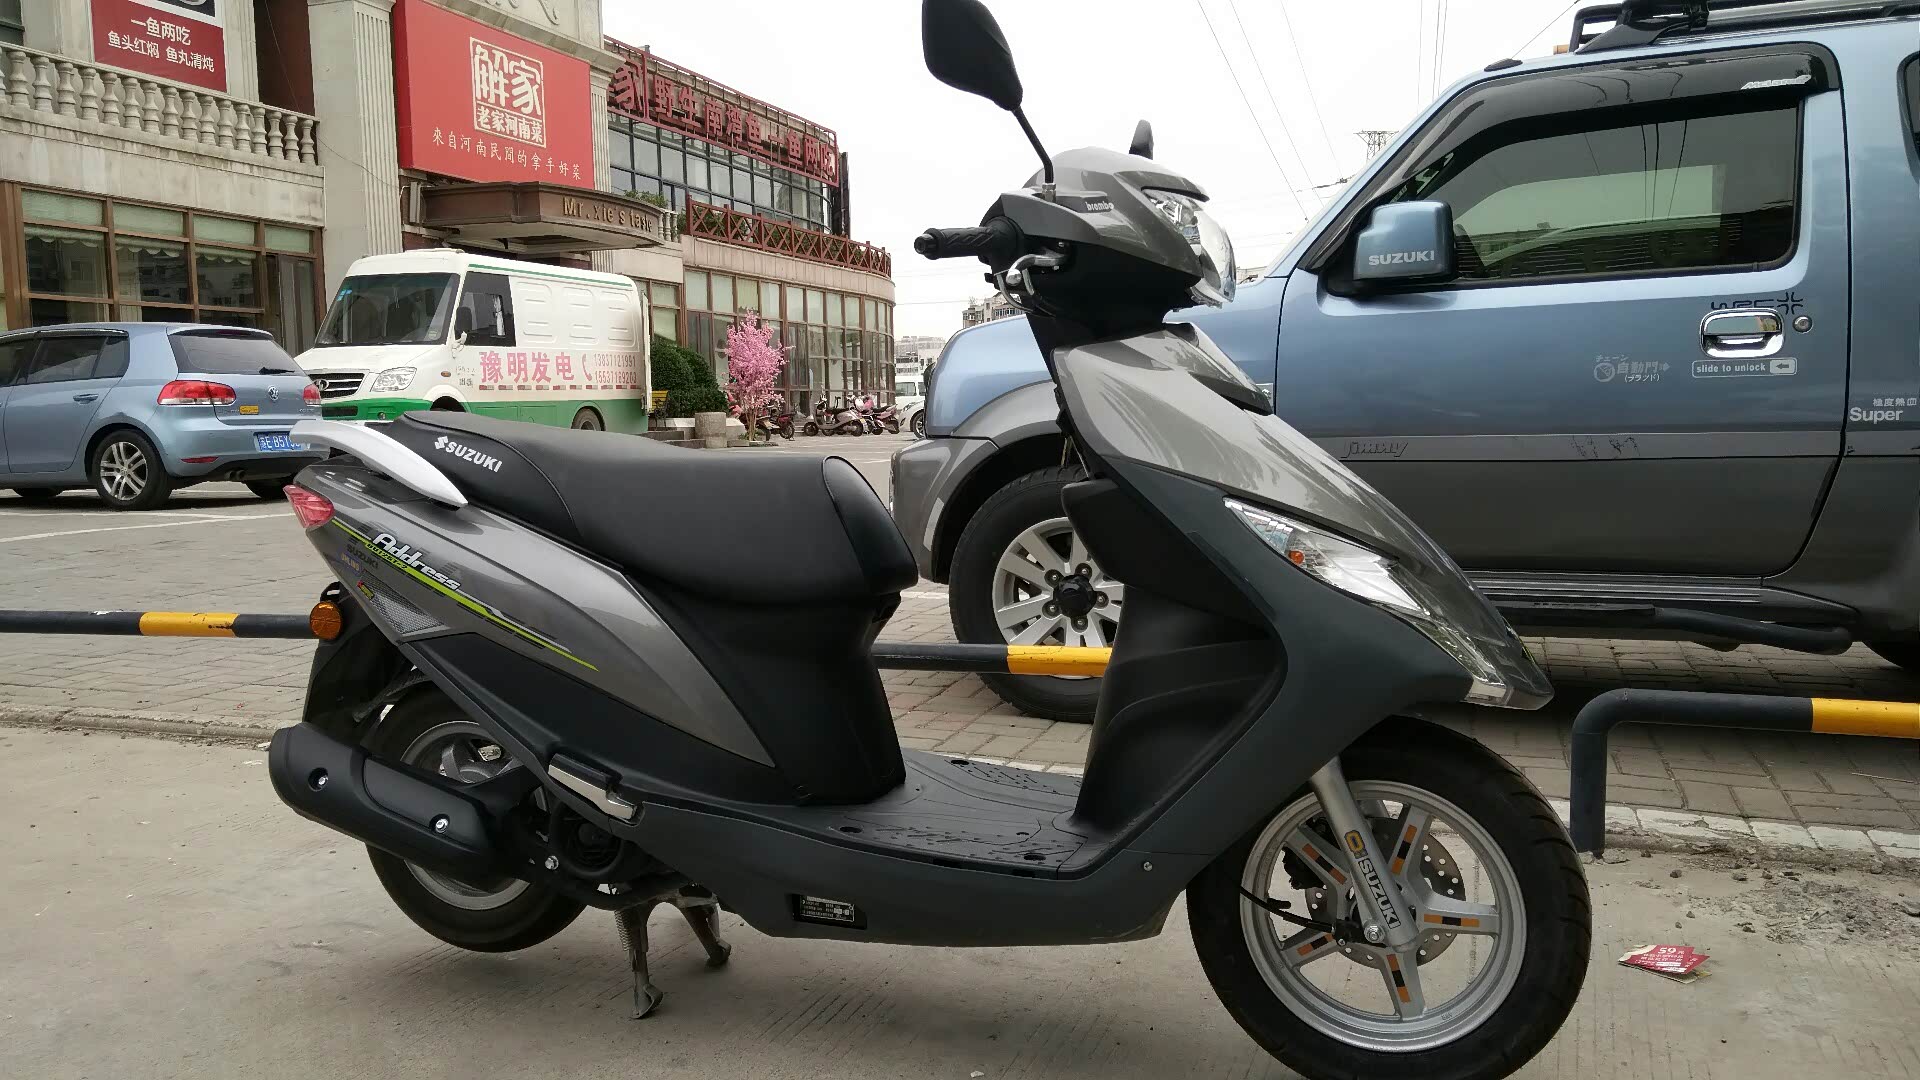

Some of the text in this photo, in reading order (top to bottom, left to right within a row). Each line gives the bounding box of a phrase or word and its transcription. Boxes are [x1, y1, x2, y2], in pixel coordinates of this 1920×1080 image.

[130, 17, 191, 46] 一鱼两吃
[107, 30, 215, 72] 鱼头红焖 鱼丸清炖
[474, 44, 541, 116] 解家
[477, 105, 543, 144] 老家河南菜
[1368, 250, 1435, 266] SUZUKI
[479, 351, 575, 384] 豫明发电
[1616, 361, 1660, 374] 自動門
[1696, 363, 1766, 373] slide to unlock
[1849, 406, 1904, 425] Super
[445, 441, 503, 473] SUZUKI
[346, 543, 379, 570] SUZUKI
[372, 532, 461, 591] Address
[1358, 857, 1402, 930] SUZUKI
